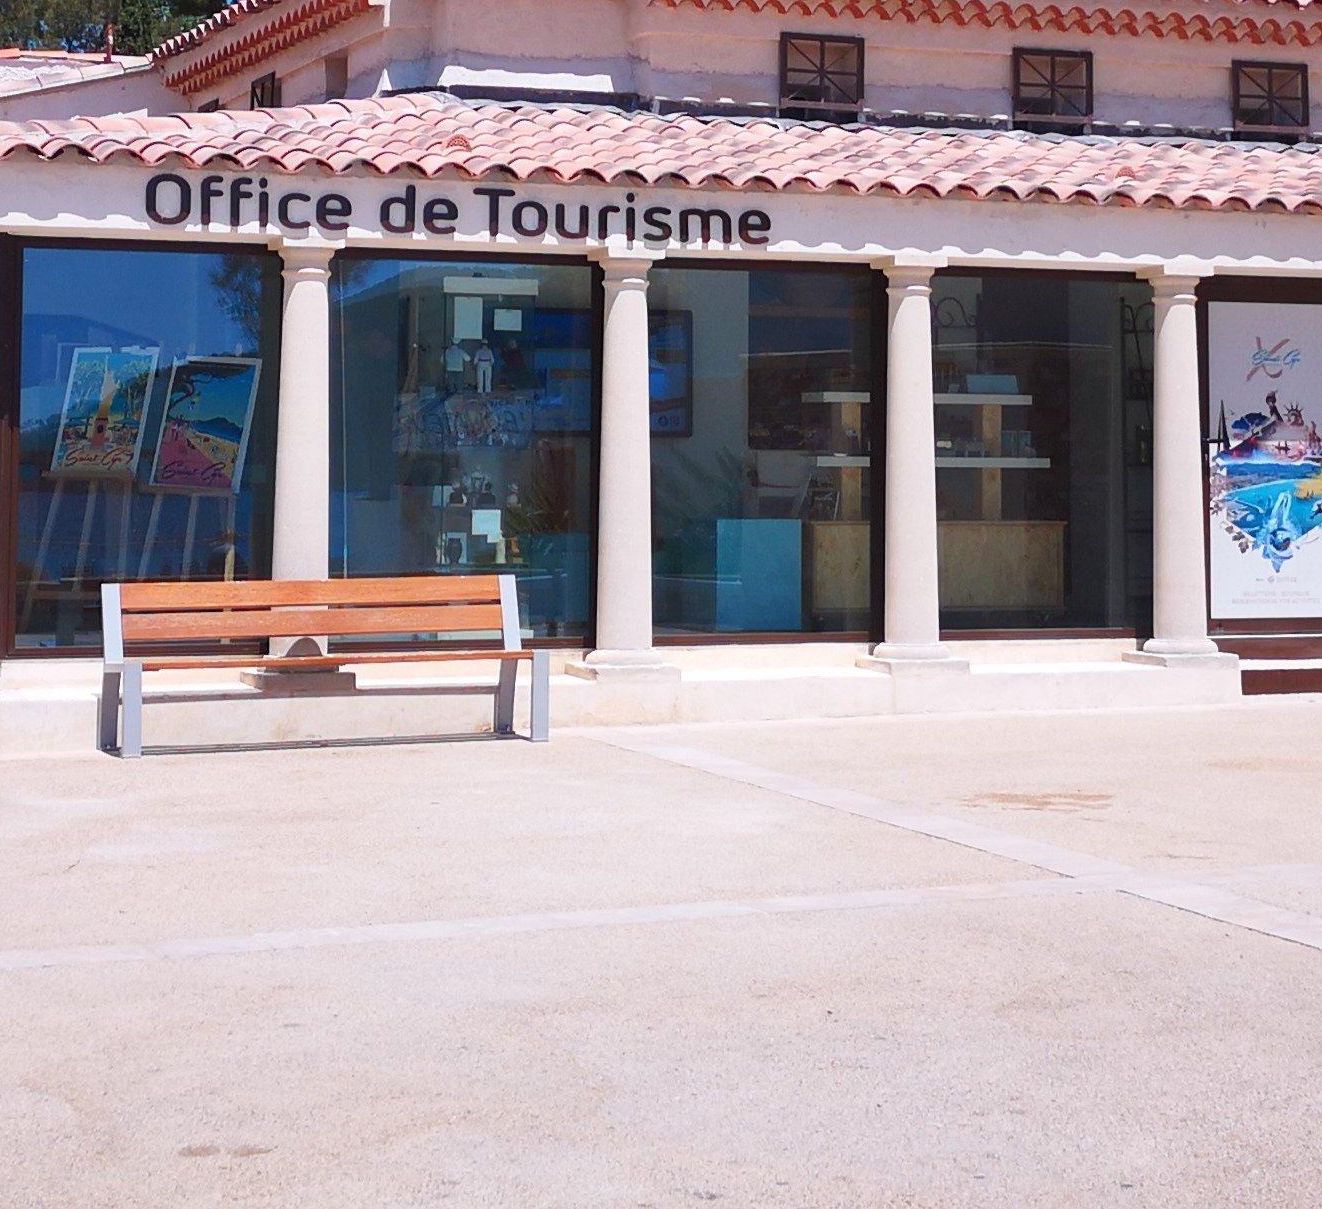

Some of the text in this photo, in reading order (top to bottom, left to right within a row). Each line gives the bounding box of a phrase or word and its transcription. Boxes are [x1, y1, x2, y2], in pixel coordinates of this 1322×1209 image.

[145, 173, 772, 244] Office de Tourisme
